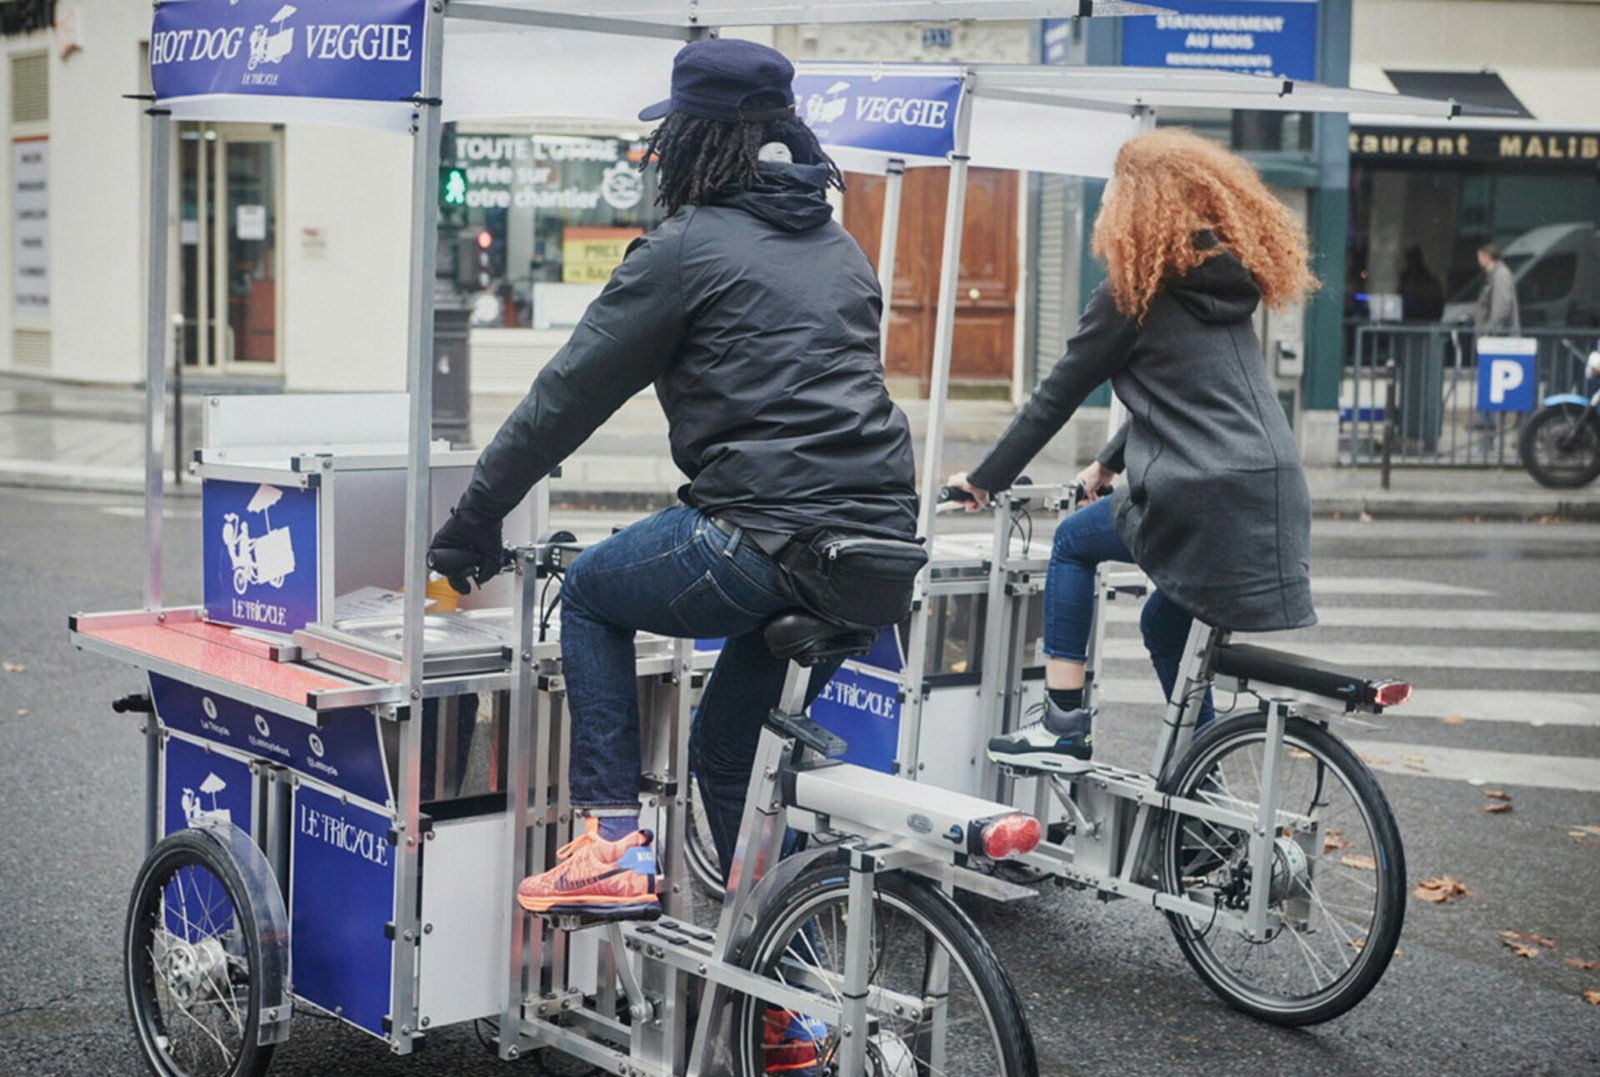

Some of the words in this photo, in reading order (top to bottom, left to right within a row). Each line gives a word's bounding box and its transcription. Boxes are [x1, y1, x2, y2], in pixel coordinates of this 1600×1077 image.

[1156, 14, 1284, 32] STATIONNEMENT
[152, 30, 192, 65] HOT
[191, 27, 245, 61] DOG
[306, 24, 412, 61] VEGGIE
[1184, 32, 1210, 48] AU
[1211, 32, 1254, 50] MOIS
[855, 96, 948, 129] VEGGIE
[455, 137, 528, 160] TOUTE
[456, 160, 513, 184] vrée
[465, 187, 511, 208] otre
[1489, 360, 1524, 404] P
[232, 598, 245, 619] LE
[818, 680, 834, 701] E
[301, 804, 320, 837] LE
